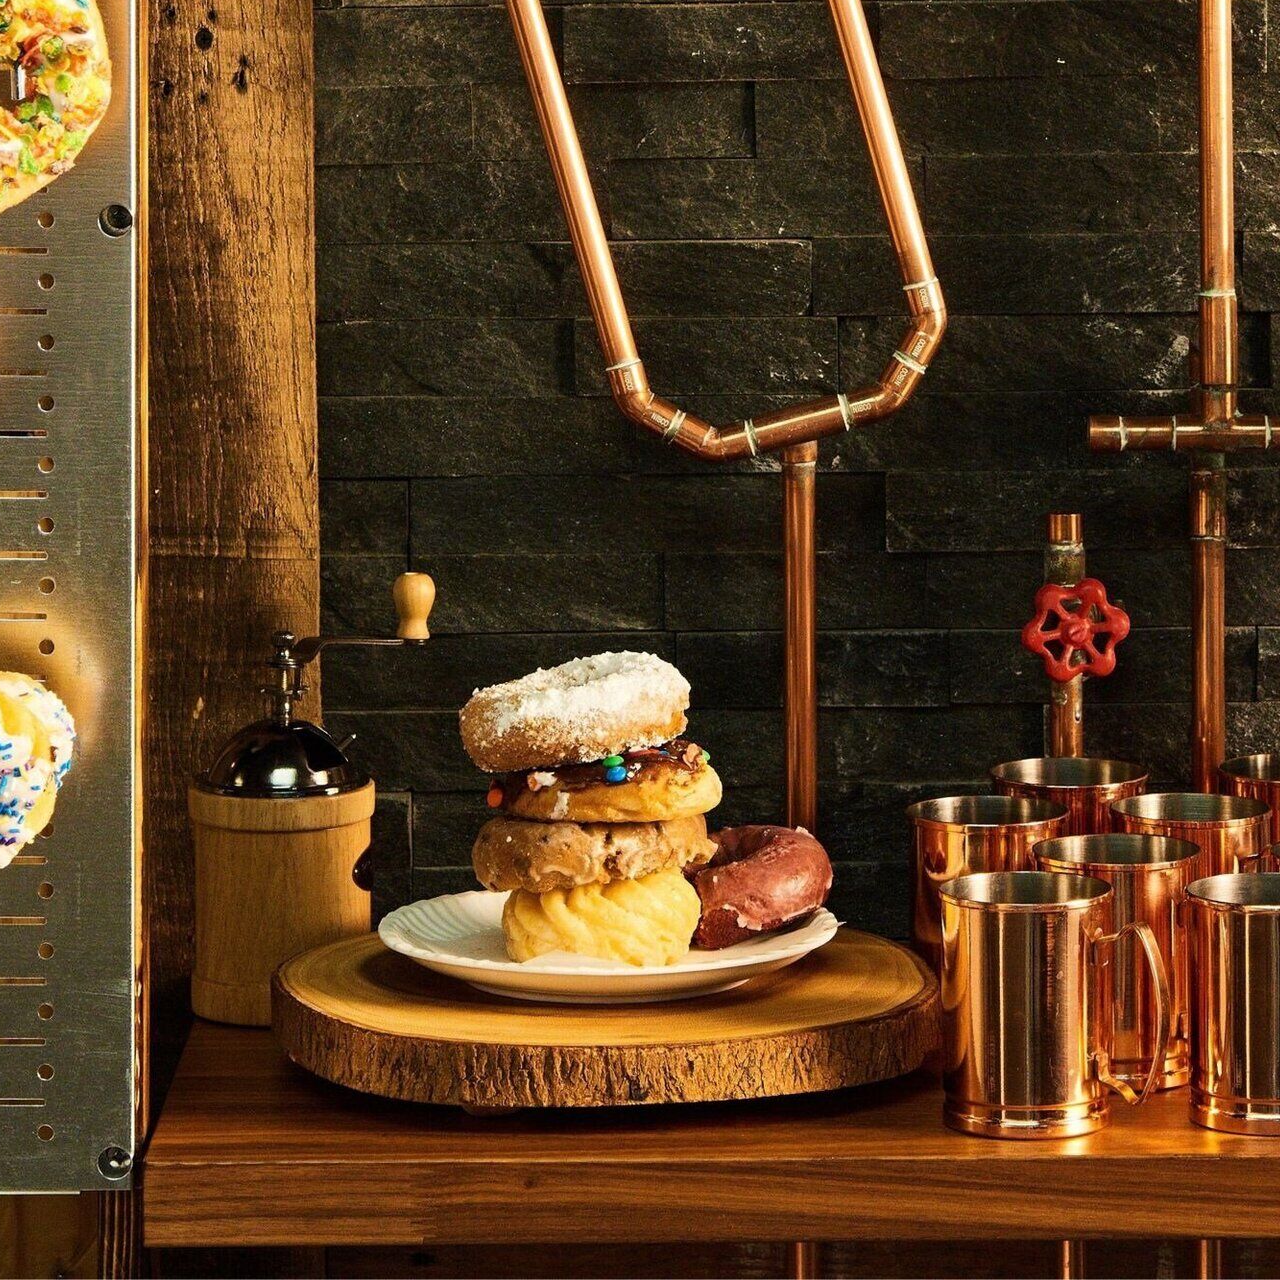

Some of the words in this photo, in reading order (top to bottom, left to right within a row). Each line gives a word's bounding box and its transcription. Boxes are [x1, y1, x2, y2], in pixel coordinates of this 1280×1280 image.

[919, 288, 930, 308] NIBCO
[911, 338, 926, 358] NIBCO
[623, 371, 634, 391] NIBCO
[895, 367, 909, 387] NIBCO
[851, 402, 872, 414] NIBCO
[650, 411, 670, 427] NIBCO
